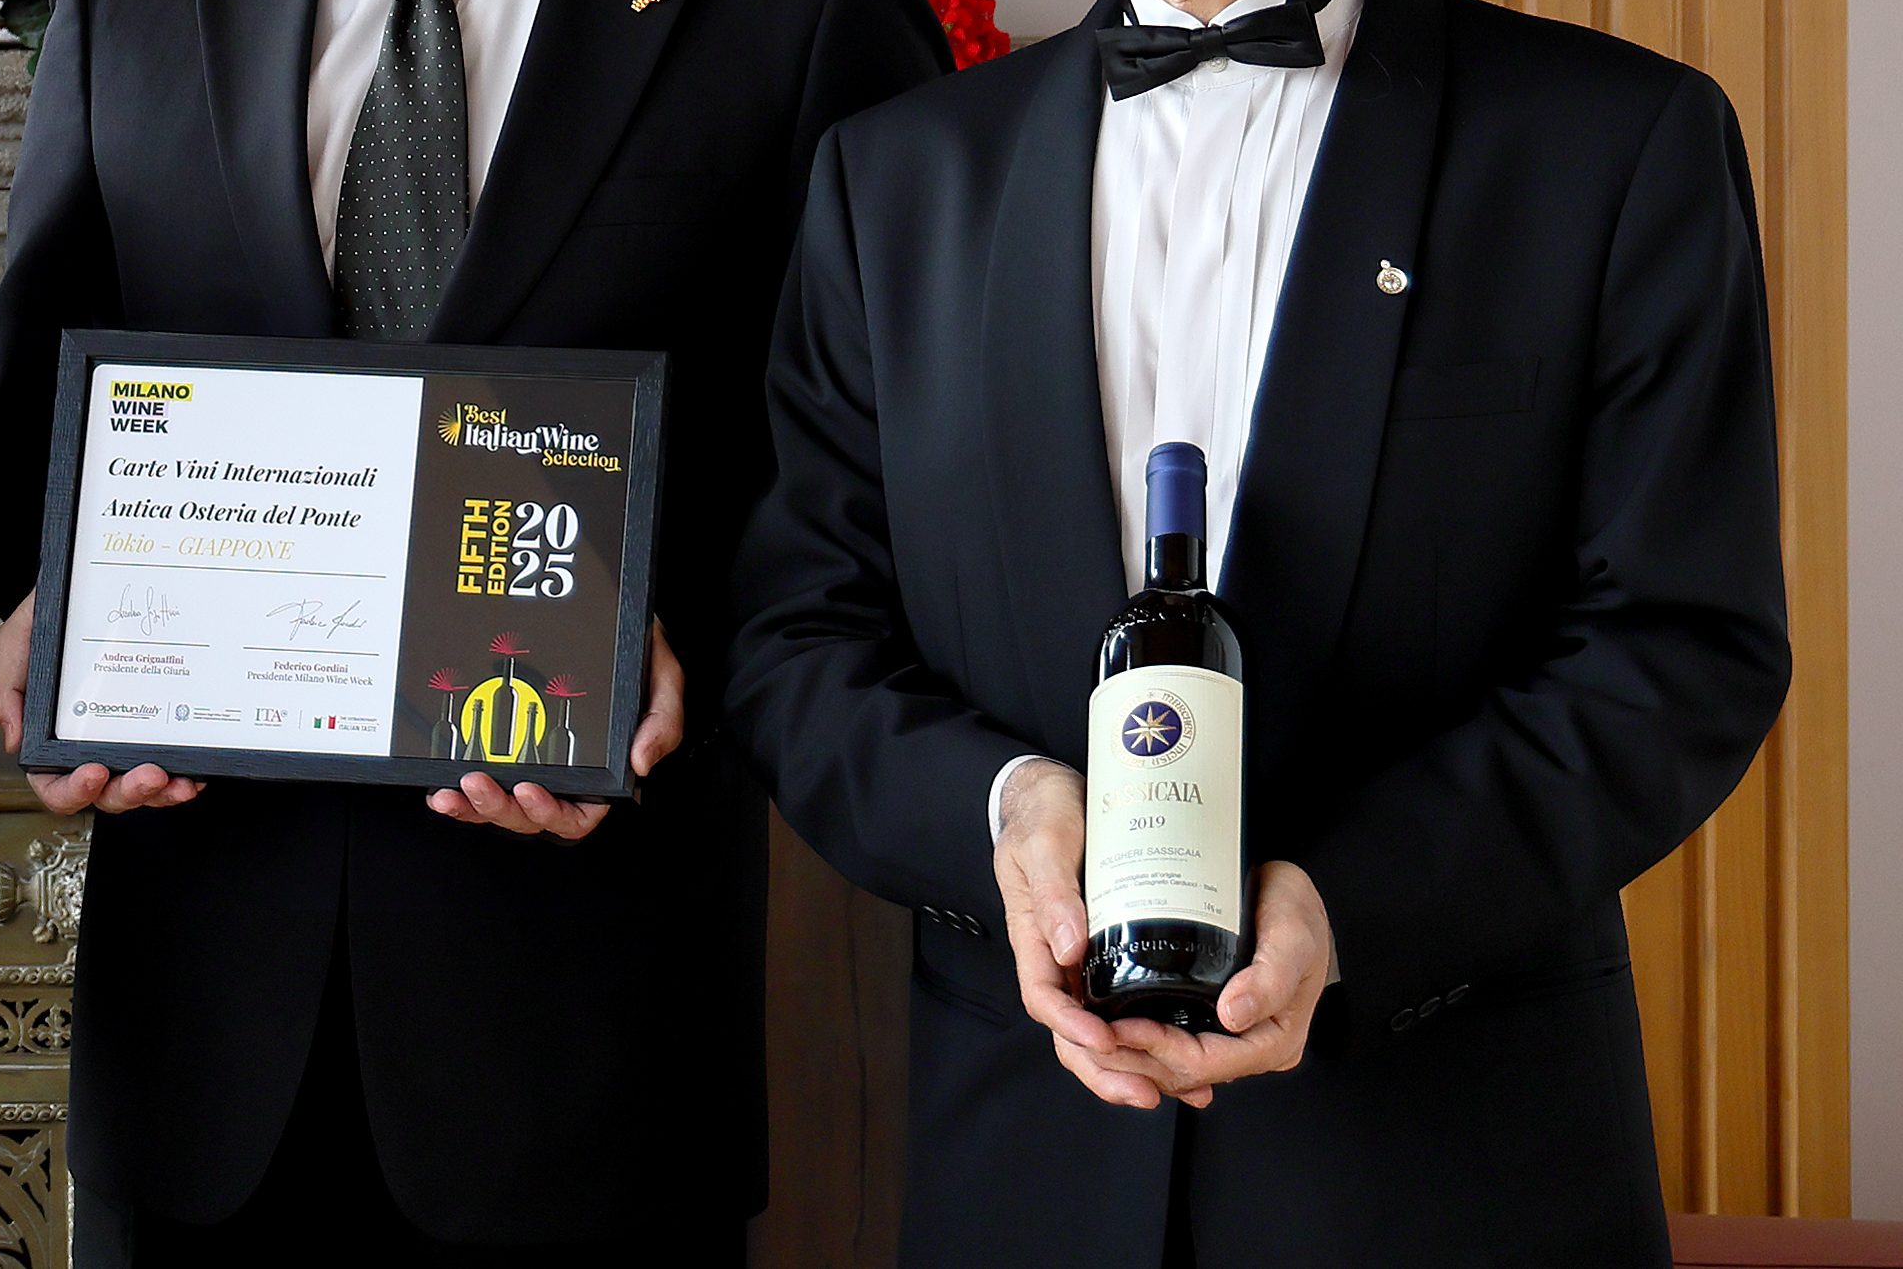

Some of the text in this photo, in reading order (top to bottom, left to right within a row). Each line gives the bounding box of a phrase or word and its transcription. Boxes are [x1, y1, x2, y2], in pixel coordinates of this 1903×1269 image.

[113, 383, 190, 399] MILANO
[112, 400, 165, 416] WINE
[464, 404, 507, 425] Best
[110, 418, 169, 433] WEEK
[464, 423, 599, 455] Italian Wine
[542, 448, 622, 472] Selection
[108, 457, 378, 487] Carte Vini Internazionali
[102, 499, 362, 528] Antica Osteria del Ponte
[512, 502, 579, 550] 20
[102, 531, 154, 554] Tokio
[178, 536, 295, 560] GIAPPONE
[457, 498, 490, 594] FIFTH
[487, 500, 512, 595] EDITION
[508, 550, 574, 598] 25
[94, 663, 190, 676] Presidente della Giuria
[101, 653, 184, 665] Andrea Grignaffini
[273, 661, 349, 673] Federico Gordini
[247, 671, 373, 686] Presidente Milano Wine Week
[1101, 781, 1204, 814] SASSICAIA
[1129, 816, 1165, 831] 2019
[1100, 849, 1143, 868] BOLGHERI
[1147, 847, 1201, 858] SASSICAIA
